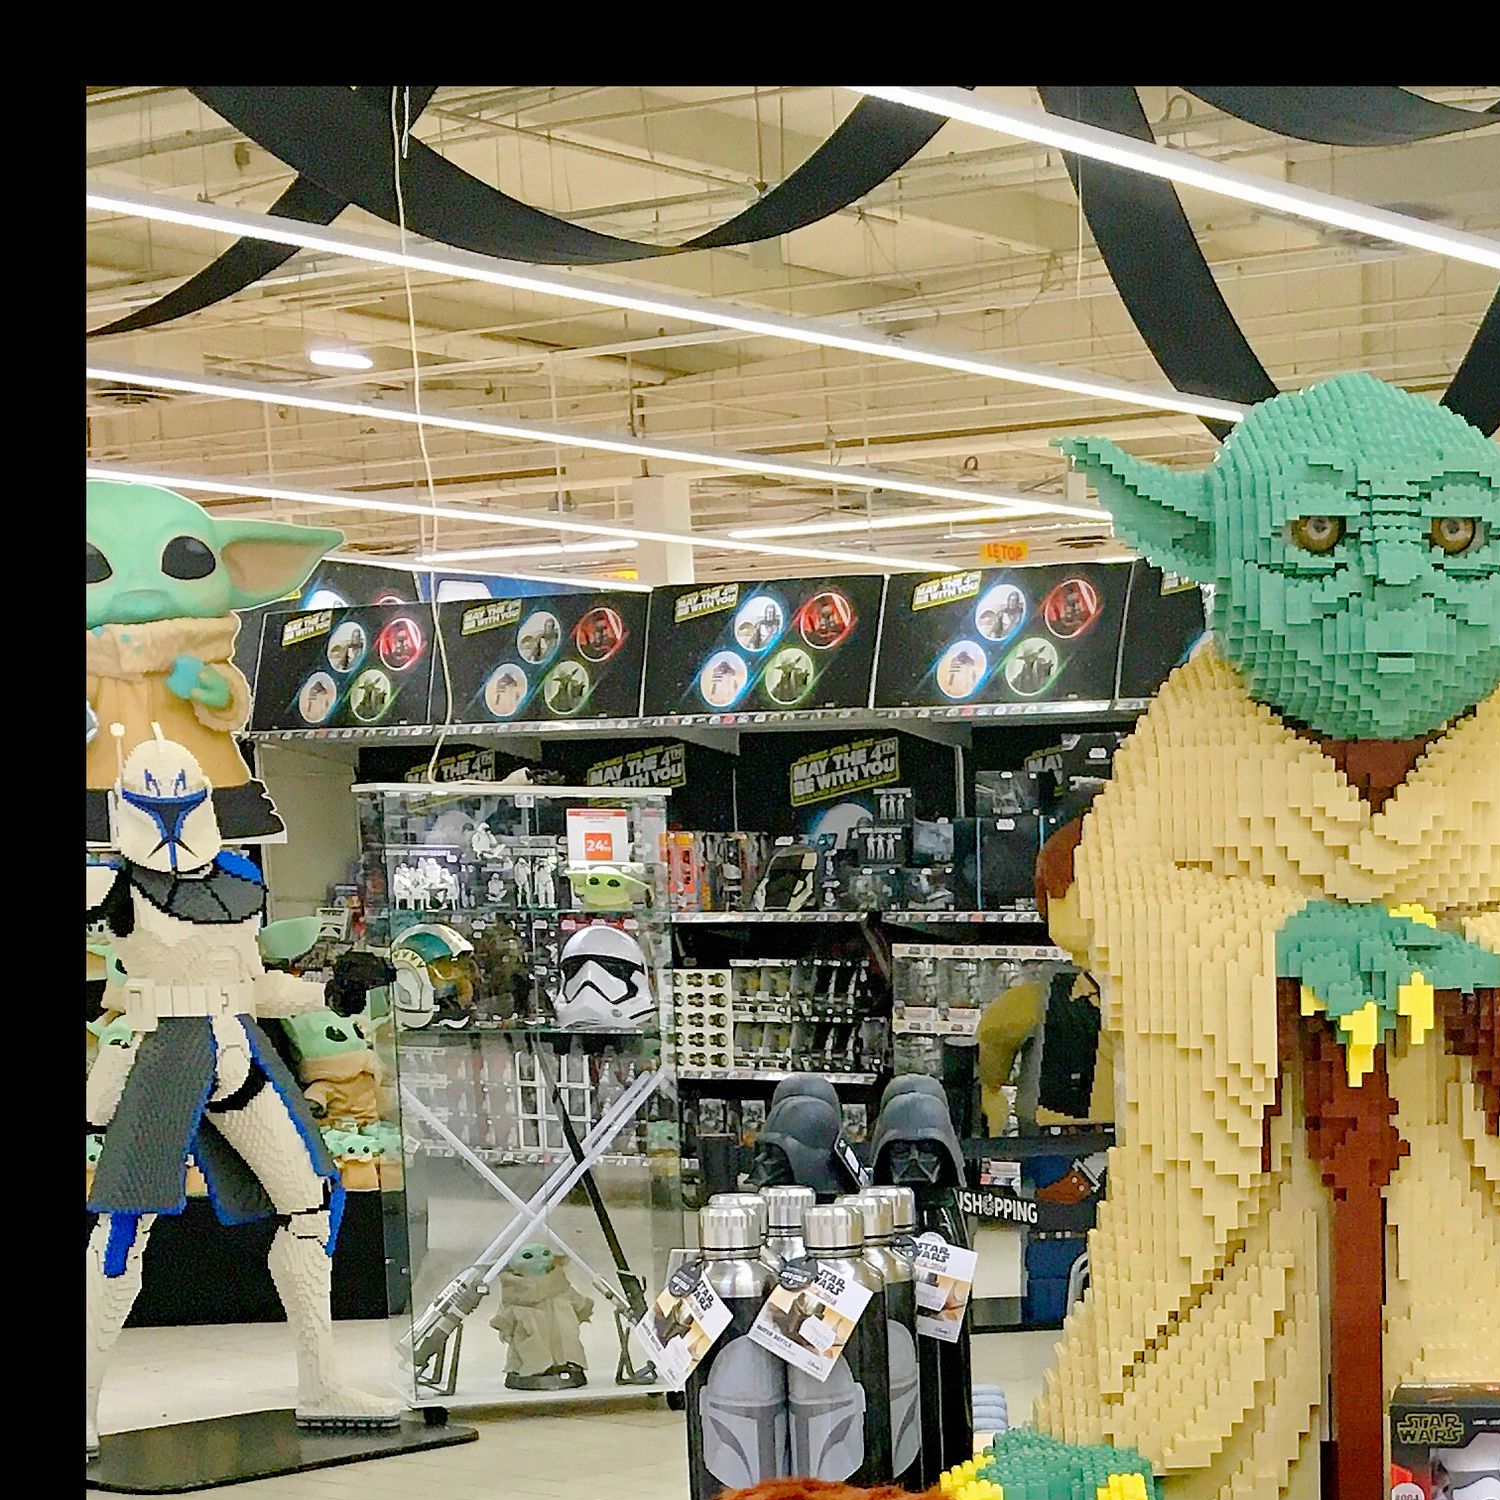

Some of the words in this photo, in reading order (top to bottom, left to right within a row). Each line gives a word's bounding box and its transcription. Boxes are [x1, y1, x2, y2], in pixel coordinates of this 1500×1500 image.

[590, 766, 625, 787] MAY
[626, 757, 657, 777] THE
[793, 759, 829, 779] MAY
[832, 749, 866, 770] THE
[870, 741, 895, 761] 4TH
[652, 764, 683, 782] YOU
[793, 780, 815, 797] BE
[816, 768, 859, 790] WITH
[861, 756, 895, 778] YOU
[1397, 1413, 1464, 1430] STAR
[1397, 1427, 1464, 1444] WARS
